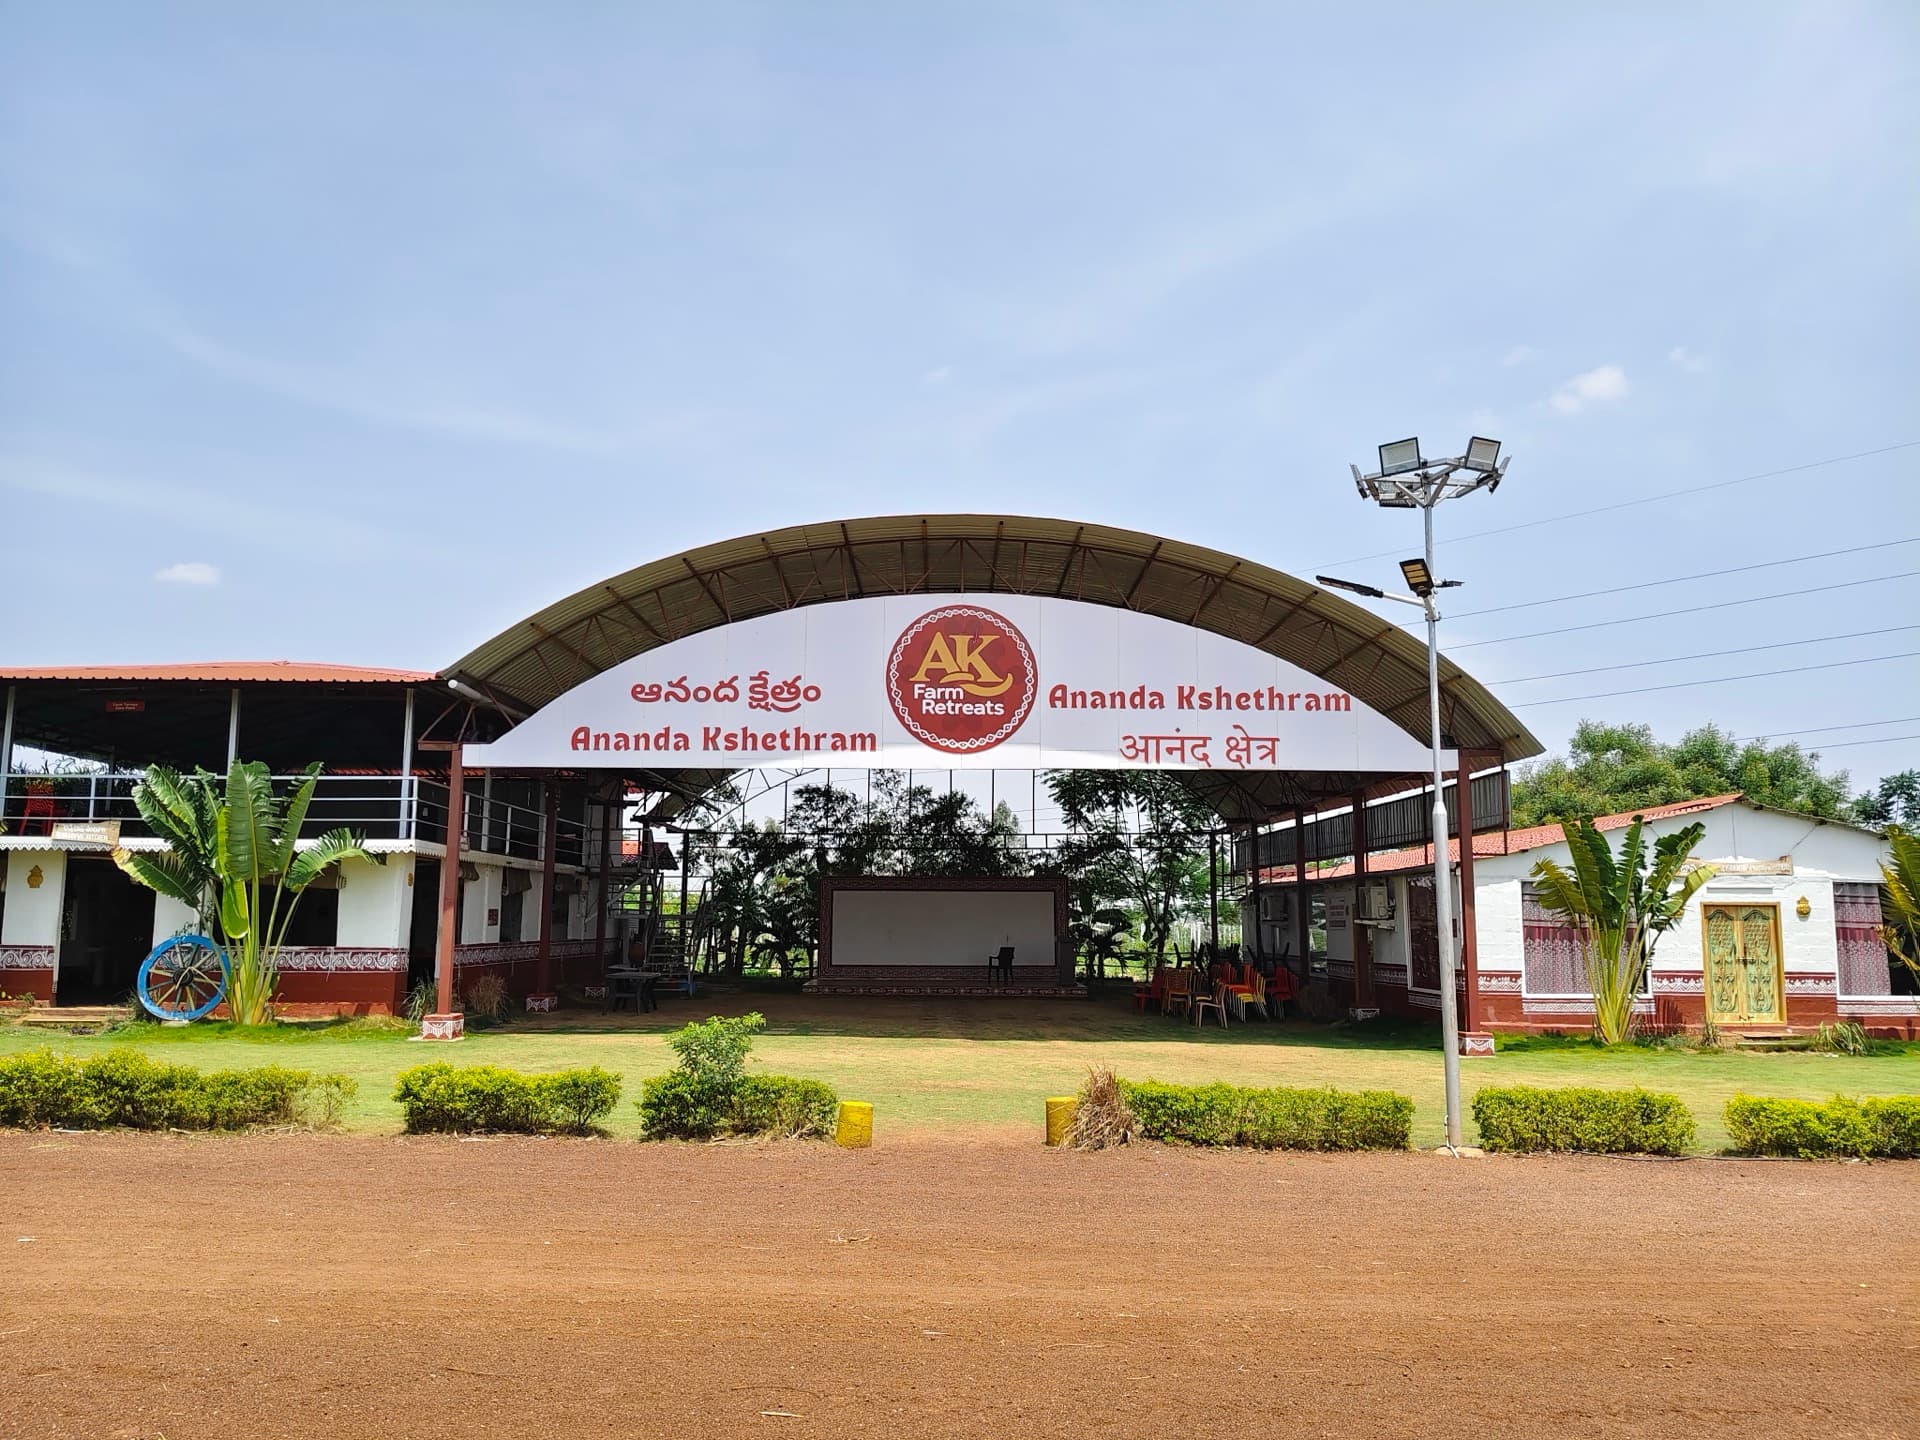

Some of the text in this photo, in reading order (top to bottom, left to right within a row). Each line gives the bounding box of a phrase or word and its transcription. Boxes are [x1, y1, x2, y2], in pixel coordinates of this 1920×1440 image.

[909, 631, 1005, 684] AK
[630, 670, 822, 712] ఆనంద క్షేత్రం
[913, 684, 964, 699] Farm
[1048, 684, 1351, 712] Ananda Kshethram
[922, 700, 1005, 715] Retreats
[571, 726, 878, 752] Ananda Kshethram
[1120, 724, 1280, 769] आनंद क्षेत्र
